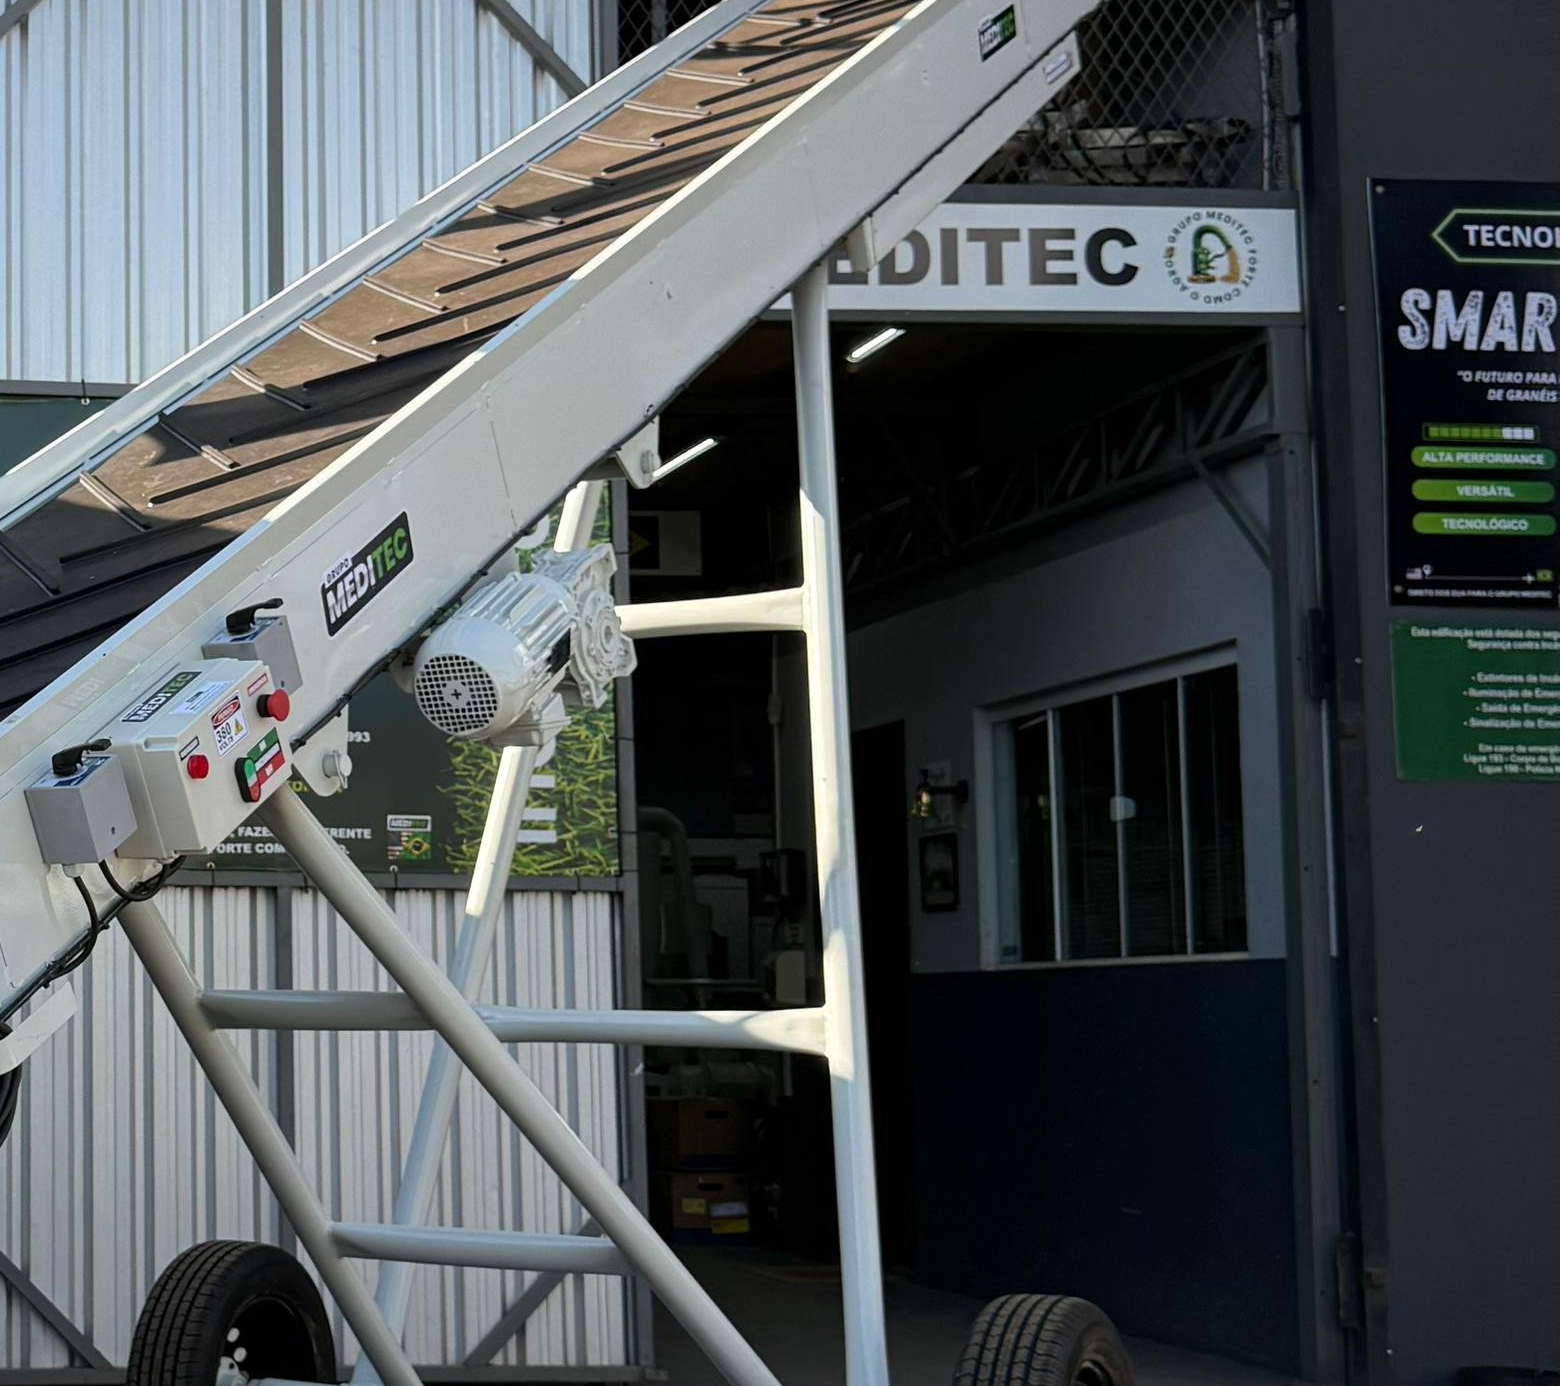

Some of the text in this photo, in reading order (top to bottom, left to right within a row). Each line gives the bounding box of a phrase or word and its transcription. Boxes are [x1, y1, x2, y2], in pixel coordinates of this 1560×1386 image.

[1167, 212, 1201, 244] GRUPO
[828, 227, 1138, 286] EDITEC
[1397, 288, 1558, 352] SMAR
[1474, 370, 1524, 384] FUTURO
[1525, 371, 1557, 385] PARA
[1487, 388, 1505, 401] DE
[1422, 452, 1545, 465] ALTA PERFORMANCE
[1456, 483, 1515, 497] VERSÁTIL
[1442, 516, 1529, 531] TECNOLÓGICO
[326, 557, 349, 583] GRUPO
[326, 527, 408, 625] MEDITEC
[129, 671, 193, 722] MEDITEC
[216, 722, 231, 743] 380
[237, 826, 274, 837] FAZE
[216, 843, 252, 854] ORTE
[255, 843, 287, 854] COM
